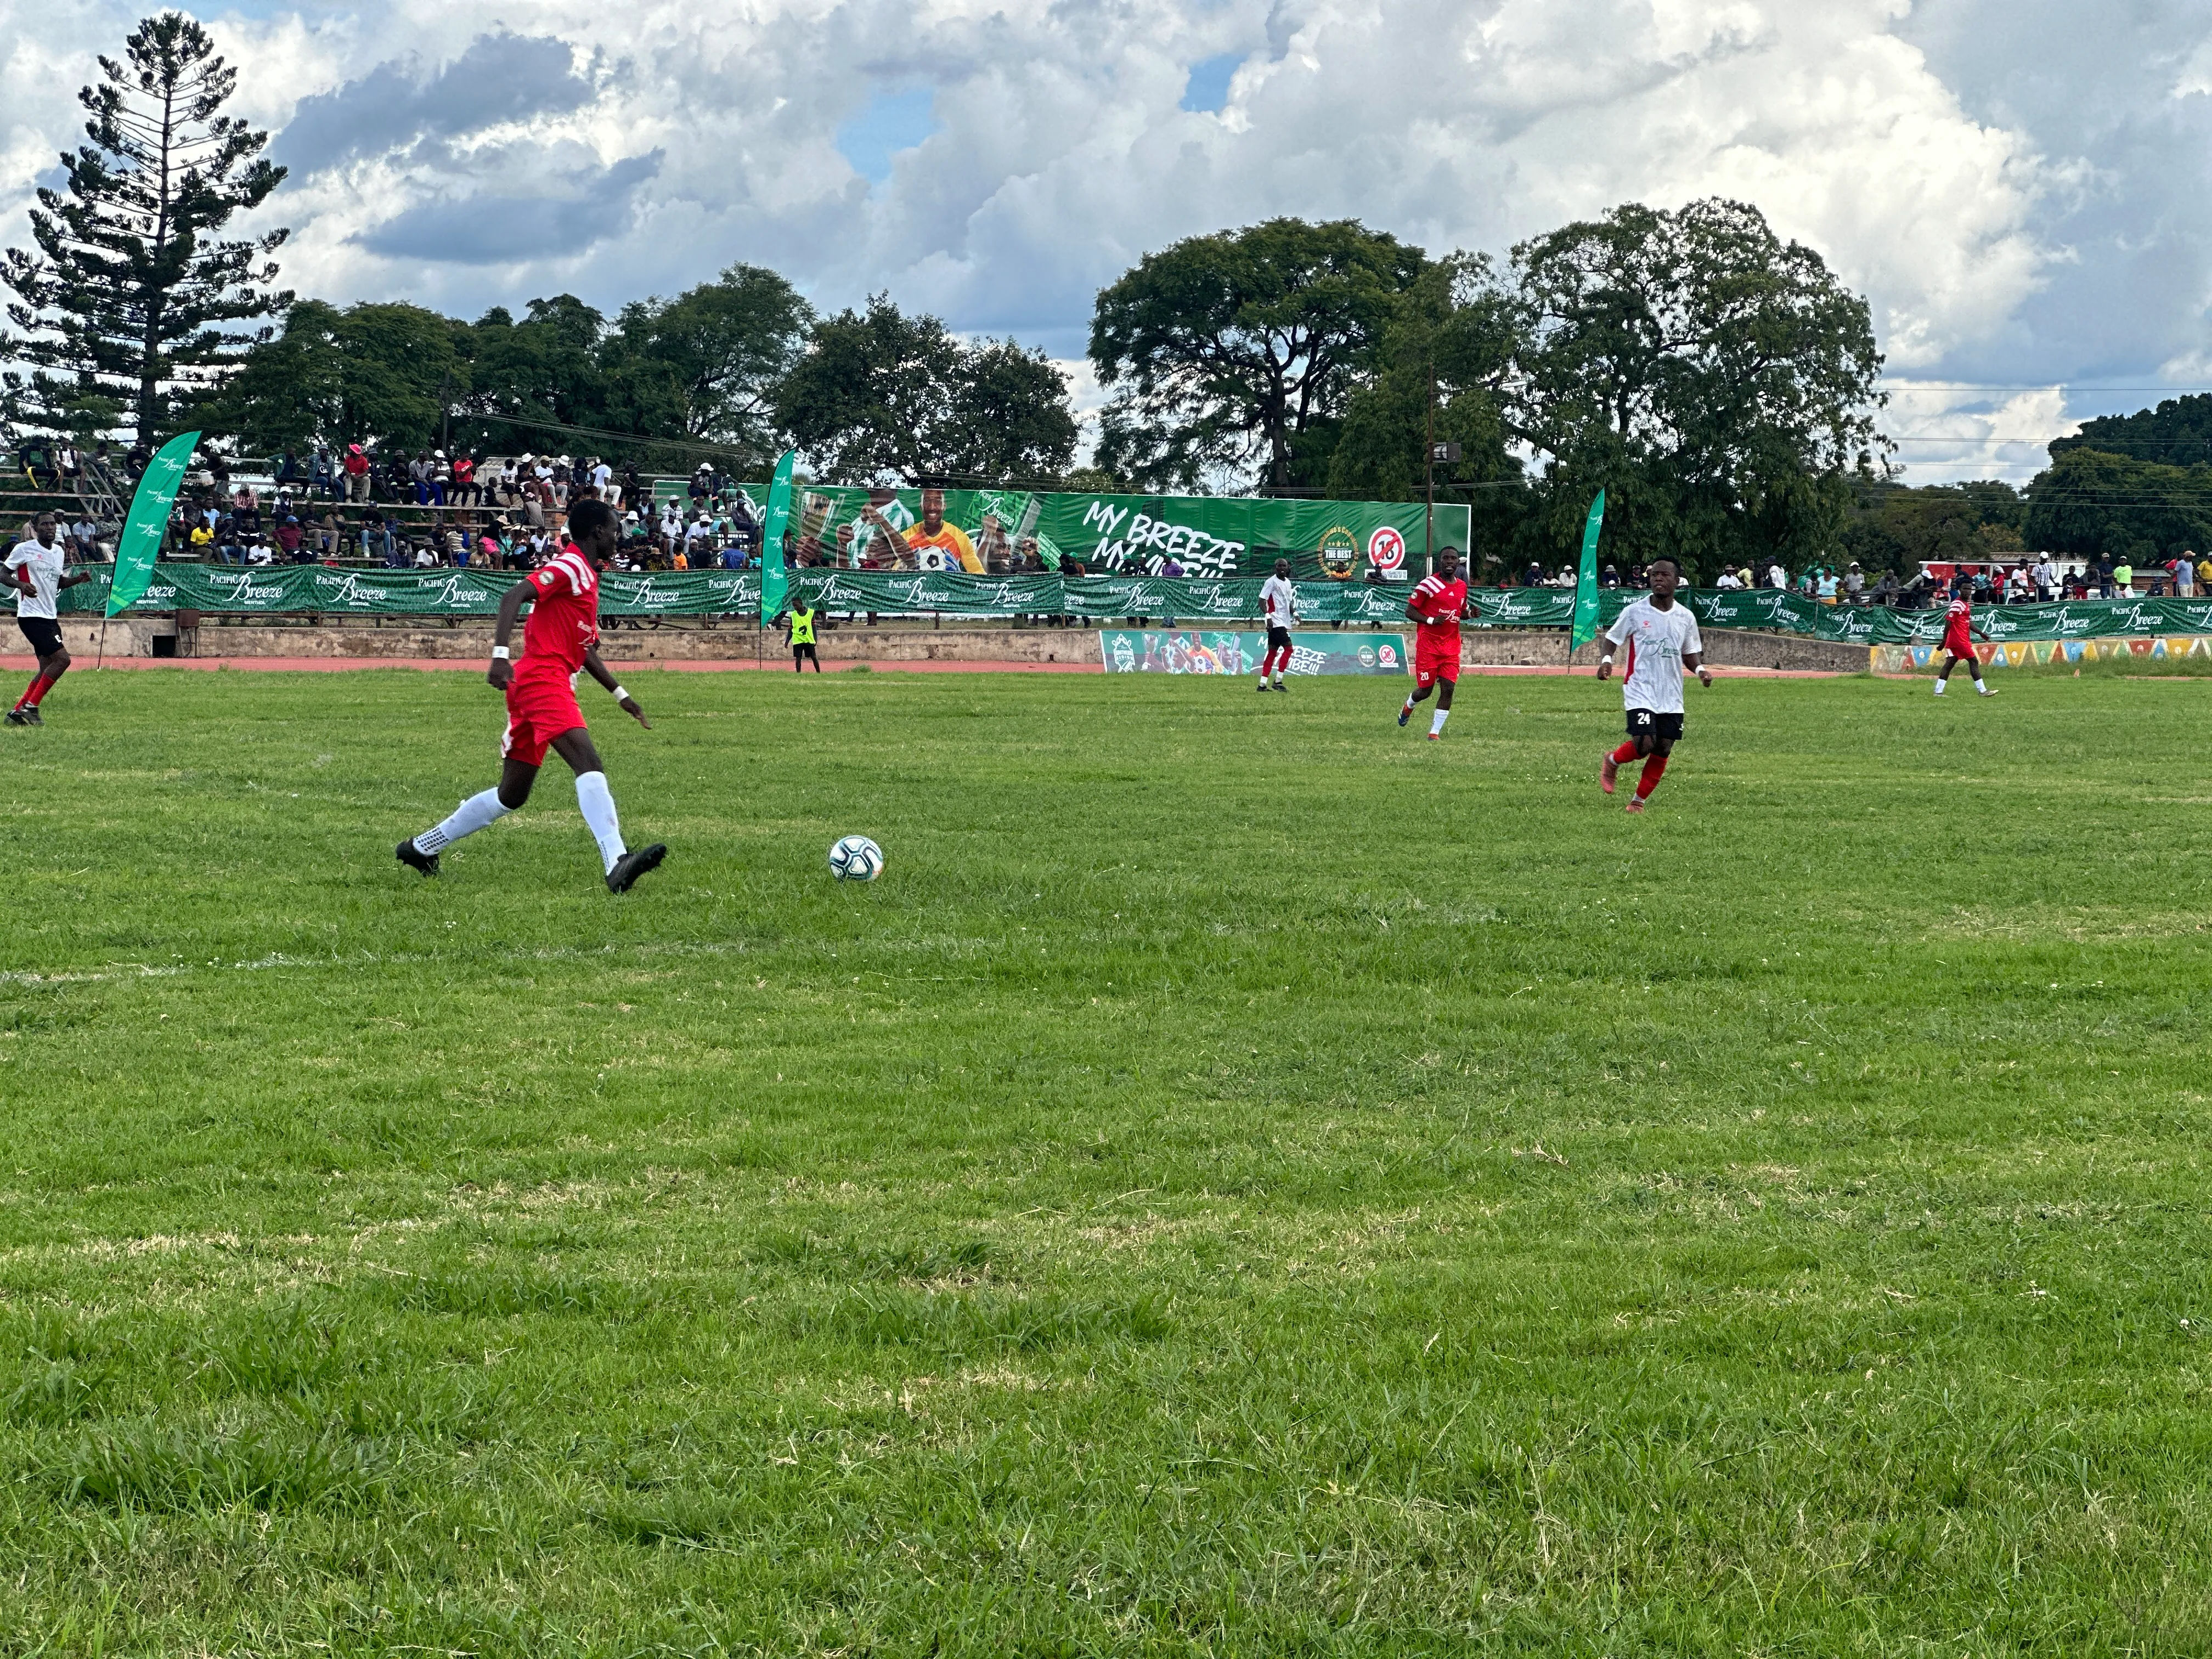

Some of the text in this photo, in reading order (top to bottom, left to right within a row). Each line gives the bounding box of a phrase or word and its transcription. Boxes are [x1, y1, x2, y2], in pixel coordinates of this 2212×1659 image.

[979, 496, 1014, 526] Breeze
[1082, 501, 1128, 535] MY
[1127, 513, 1245, 569] BREEZE
[1325, 550, 1352, 558] THE BEST
[210, 574, 238, 584] PACIFIC
[222, 571, 283, 602] Breeze
[316, 575, 345, 585] PACIFIC
[327, 573, 387, 602] Breeze
[418, 578, 445, 588] PACIFIC
[614, 580, 639, 590] PACIFIC
[708, 579, 733, 589] PACIFIC
[800, 577, 824, 586] PACIFIC
[808, 574, 862, 602] Breeze
[889, 579, 912, 589] PACIFIC
[141, 585, 176, 597] reeze
[428, 574, 488, 605] Breeze
[624, 577, 680, 606] Breeze
[719, 575, 761, 605] Bree
[900, 577, 949, 603] Breeze
[988, 580, 1035, 605] Breeze
[1109, 586, 1131, 595] PACIFIC
[1119, 582, 1164, 610] Breeze
[1189, 586, 1211, 595] PACIFIC
[1198, 584, 1244, 610] Breeze
[1344, 590, 1364, 599] PACIFIC
[1482, 595, 1502, 603] PACIFIC
[1064, 594, 1085, 605] eeze
[1351, 588, 1395, 613] Breeze
[1489, 592, 1531, 617] Breeze
[1552, 596, 1572, 604] PACIFIC
[1701, 594, 1738, 619] Breeze
[2187, 605, 2208, 613] PACIFIC
[2046, 606, 2090, 633] Breeze
[2112, 606, 2132, 615] PACIFIC
[2119, 603, 2163, 629] Breeze
[1836, 610, 1874, 634] Breeze
[1977, 609, 2017, 635] Breeze
[1288, 657, 1320, 676] IBE!!!
[1420, 672, 1429, 680] 20
[1637, 712, 1651, 725] 24
